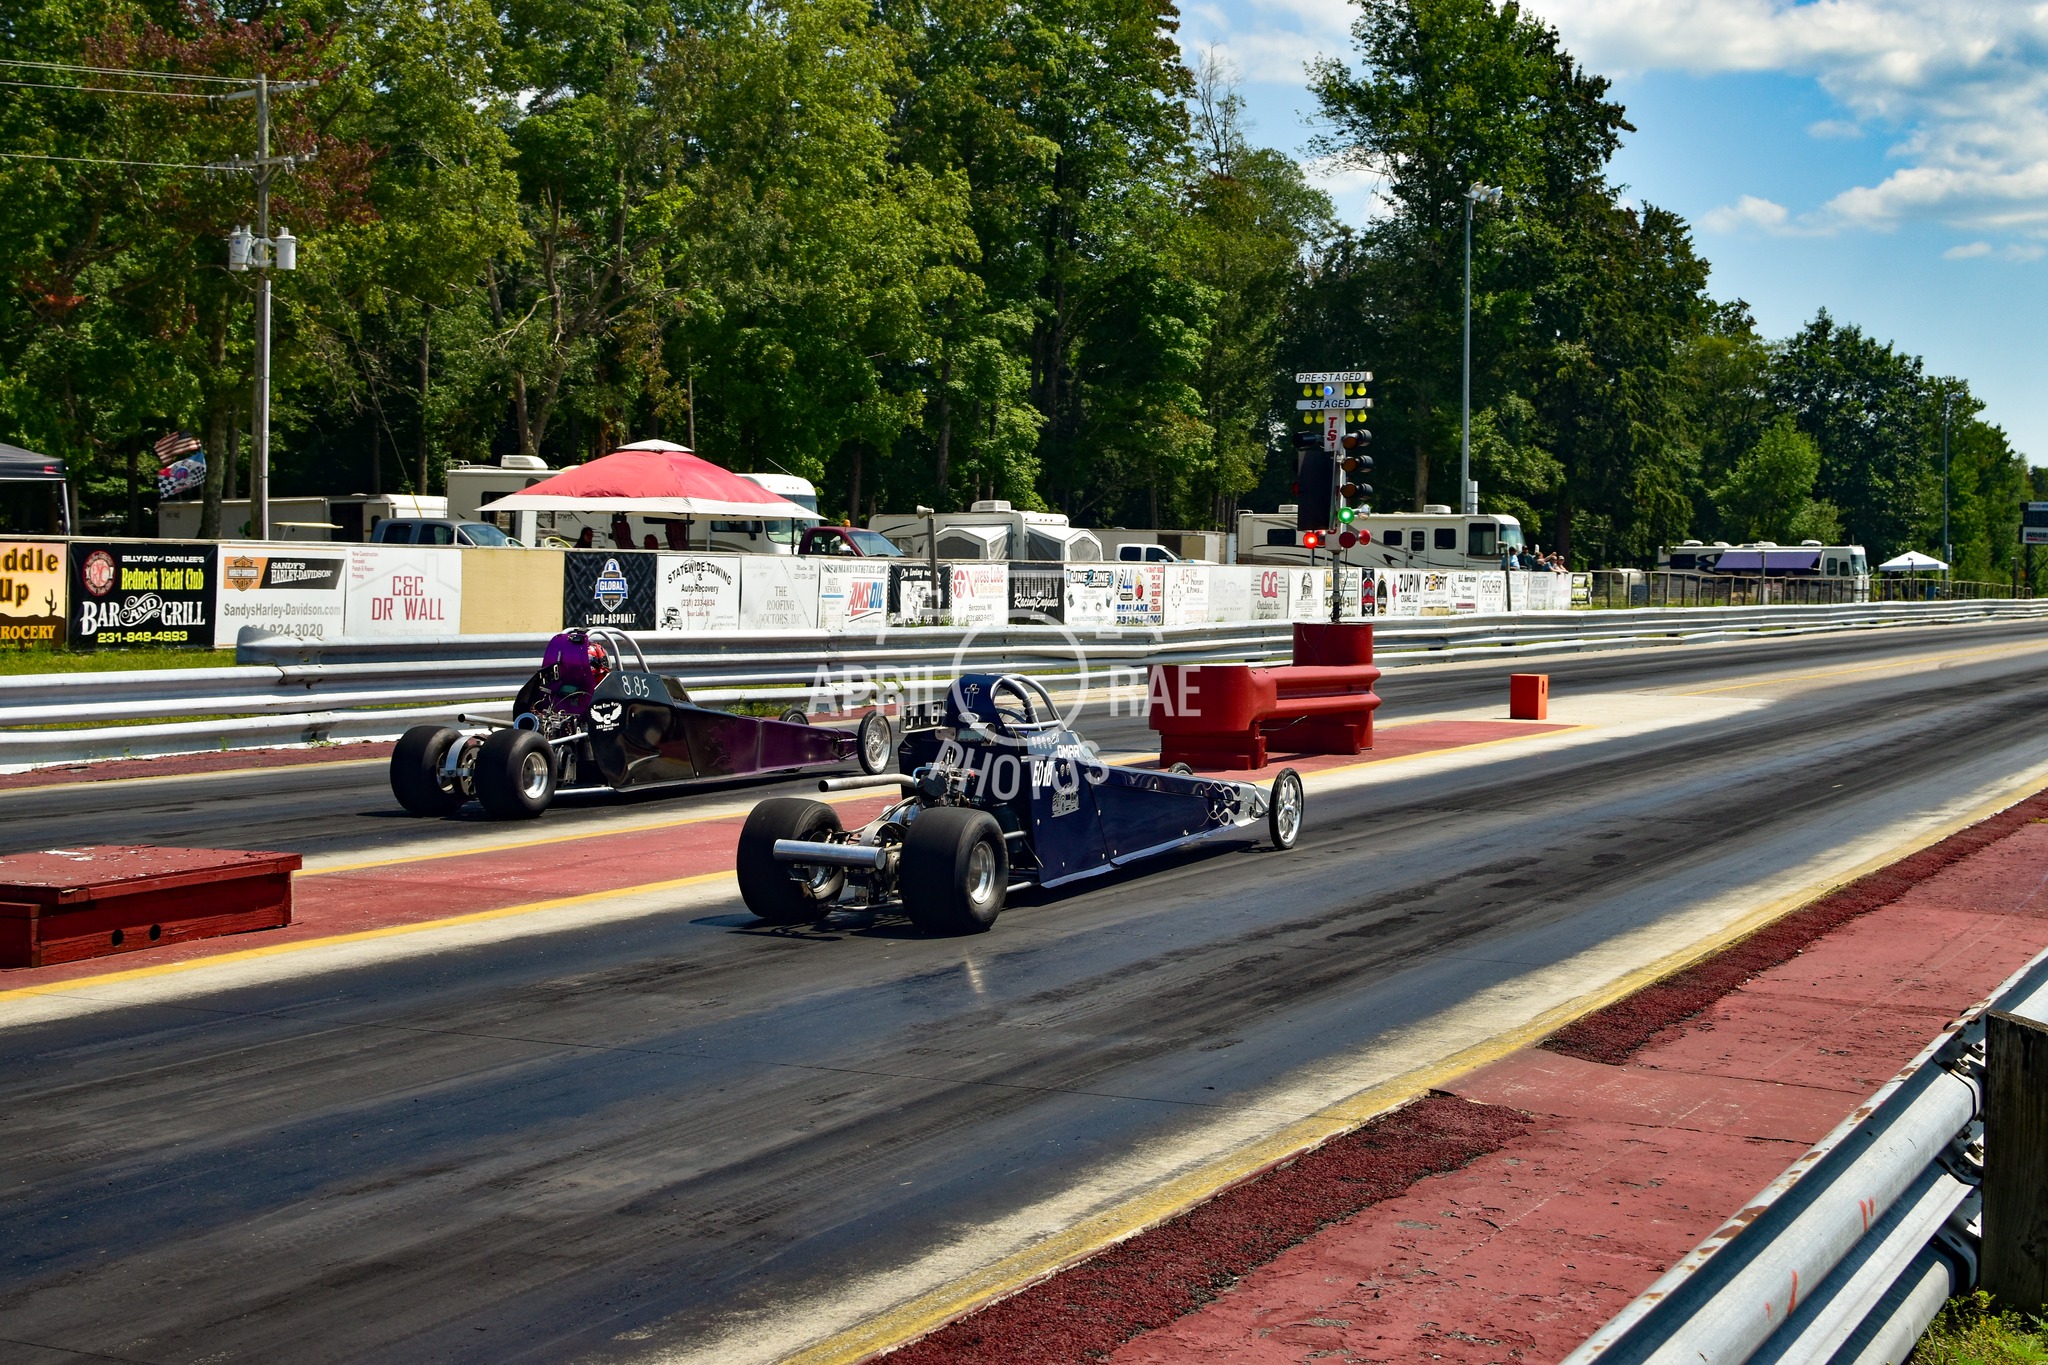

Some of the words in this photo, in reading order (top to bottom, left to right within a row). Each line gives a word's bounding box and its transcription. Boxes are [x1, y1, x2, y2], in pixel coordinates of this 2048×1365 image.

[1298, 372, 1362, 383] PRE-STAGED
[1310, 399, 1351, 409] STAGED
[0, 547, 59, 573] ddle
[122, 555, 142, 563] BILLY
[142, 555, 158, 563] RAY
[271, 562, 305, 570] SANDY'S
[121, 567, 159, 590] Redneck
[160, 568, 184, 590] Yacht
[185, 568, 205, 590] Club
[271, 569, 331, 585] HARLEY-DAVIDSON
[668, 561, 705, 584] STATEWIDE
[707, 562, 732, 586] TOWING
[393, 576, 424, 596] C&C
[600, 581, 624, 591] GLOBAL
[681, 584, 694, 593] Auto
[695, 584, 719, 594] Recovery
[1399, 574, 1421, 593] ZUPIN
[775, 586, 787, 597] THE
[847, 582, 884, 616] AMSOIL
[371, 598, 393, 620] DR
[404, 598, 445, 620] WALL
[767, 600, 795, 610] ROOFING
[1014, 593, 1036, 612] Racing
[80, 601, 120, 636] BAR
[126, 598, 158, 623] AND
[160, 601, 206, 626] GRILL
[224, 603, 341, 619] SandysHarley-Davidson.com
[0, 625, 56, 639] ROCERY
[97, 631, 188, 643] 231-848-4993
[245, 624, 323, 637] -924-3020
[622, 675, 650, 698] 8.85
[1057, 745, 1080, 758] OMAR
